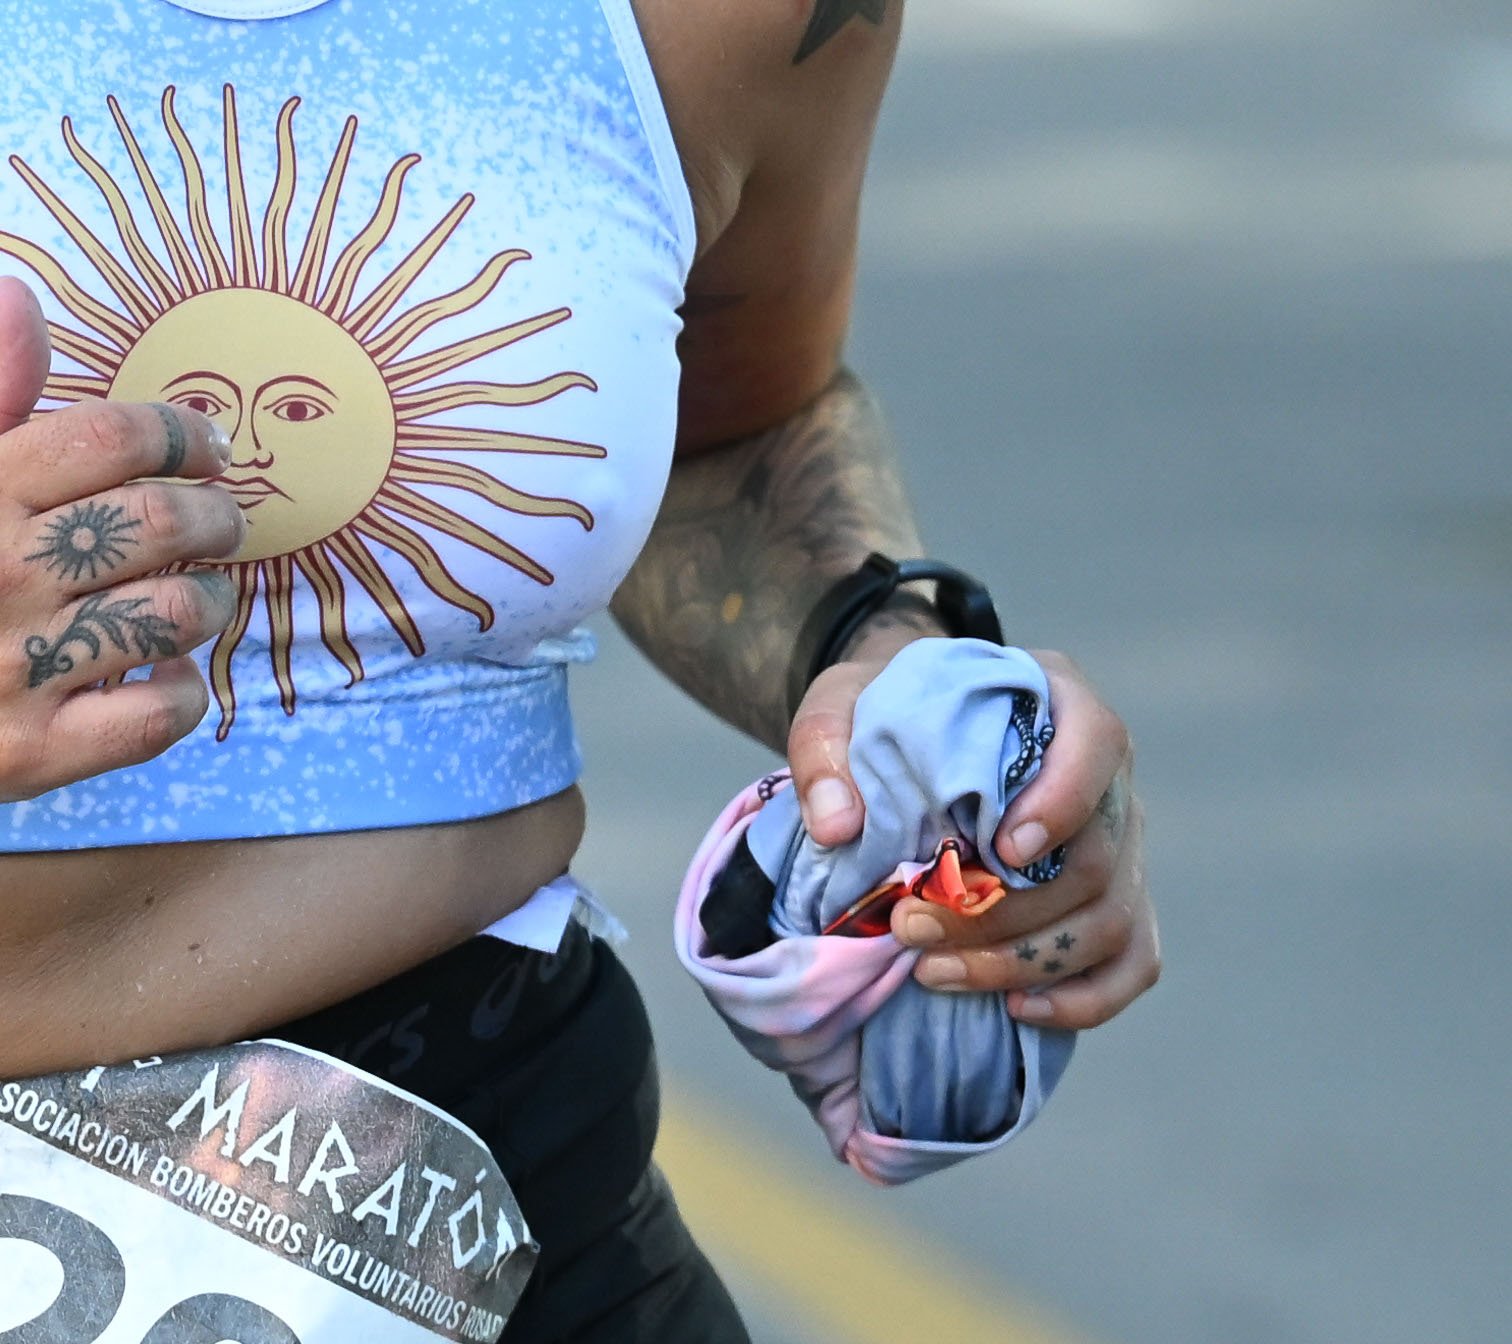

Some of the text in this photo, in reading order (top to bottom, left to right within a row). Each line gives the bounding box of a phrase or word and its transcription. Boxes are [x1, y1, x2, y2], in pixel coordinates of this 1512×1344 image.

[150, 1156, 308, 1255] BOMBEROS
[310, 1232, 466, 1331] VOLUNTARIOS
[460, 1305, 508, 1344] ROSAR
